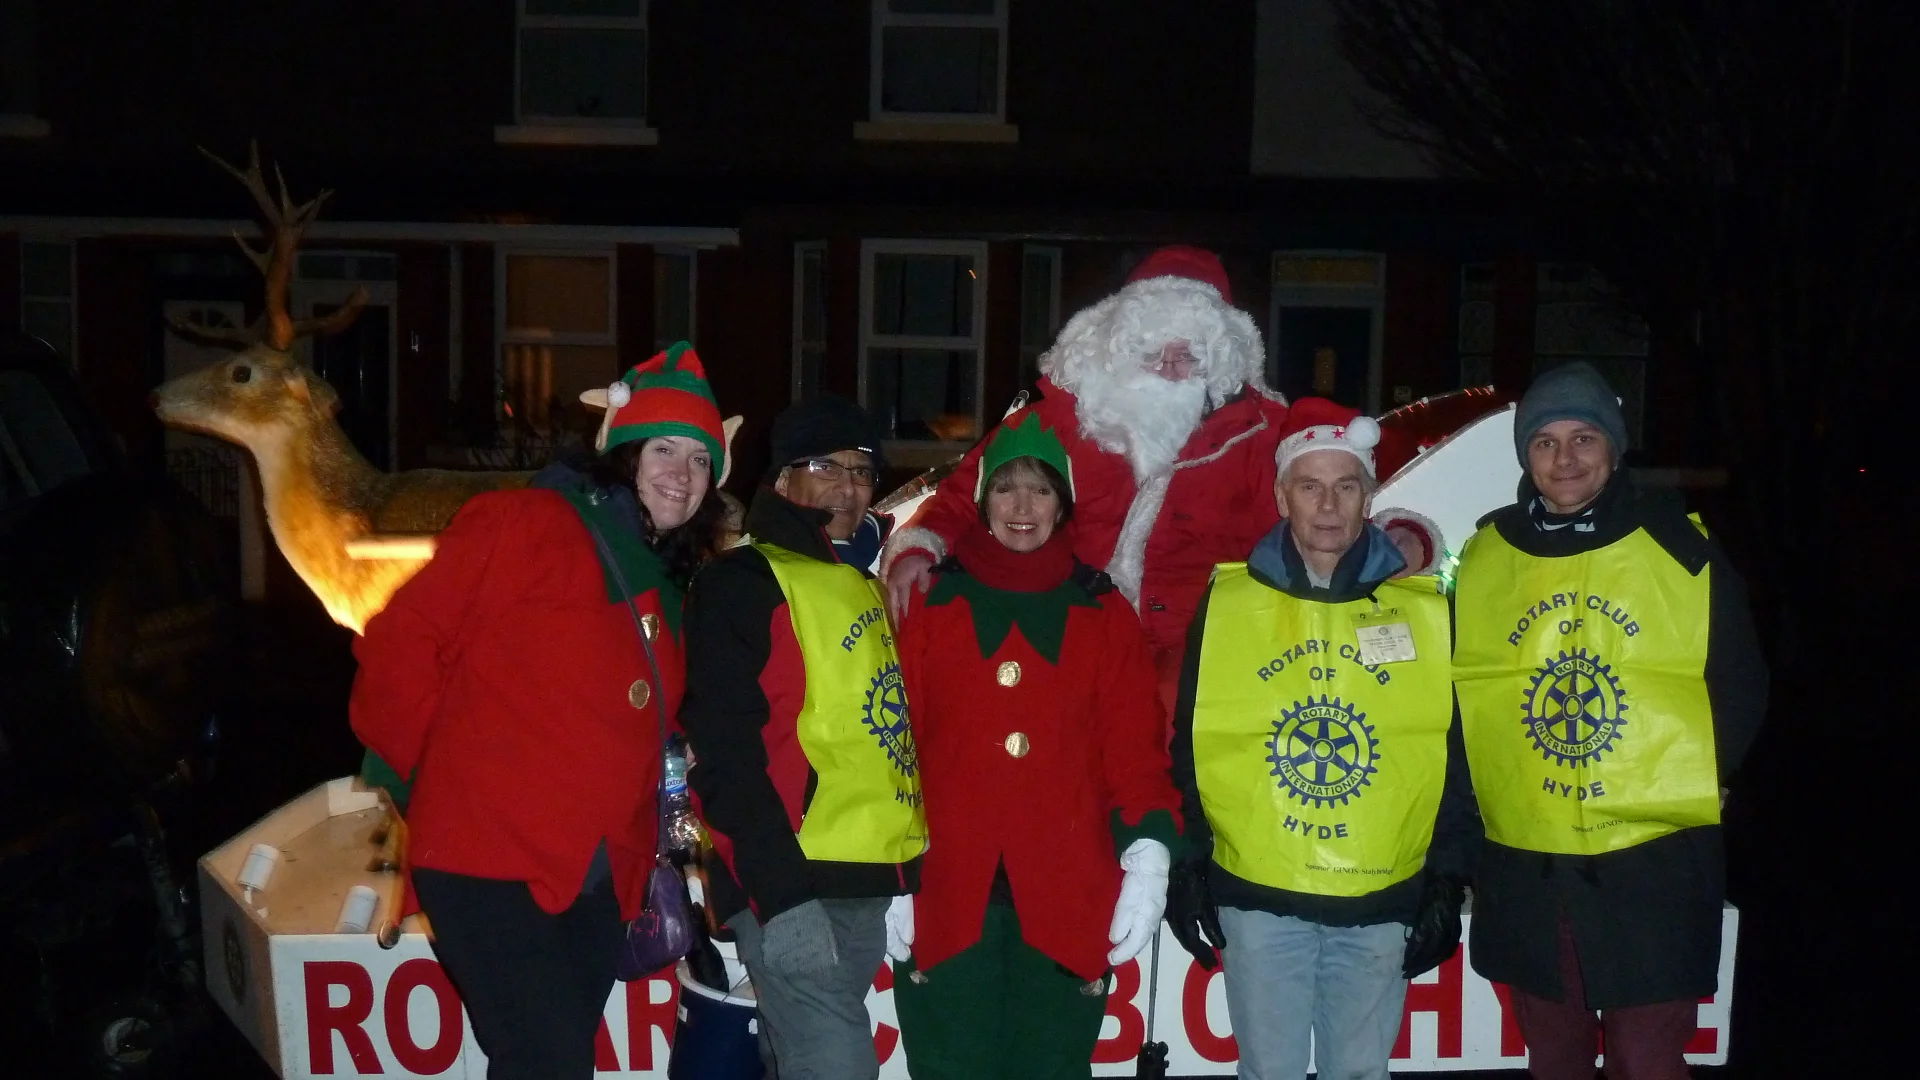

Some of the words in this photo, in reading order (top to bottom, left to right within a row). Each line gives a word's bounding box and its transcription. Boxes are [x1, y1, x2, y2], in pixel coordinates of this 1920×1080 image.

[1508, 591, 1579, 647] ROTARY
[1586, 595, 1640, 637] CLUB
[1558, 618, 1584, 635] OF
[1257, 639, 1330, 683] ROTARY
[1309, 666, 1337, 682] OF
[1301, 707, 1348, 722] ROTARY
[1536, 722, 1612, 755] INTERNATIONAL
[1281, 760, 1363, 797] INTERNATIONAL
[1543, 777, 1606, 801] HYDE
[1282, 815, 1349, 840] HYDE
